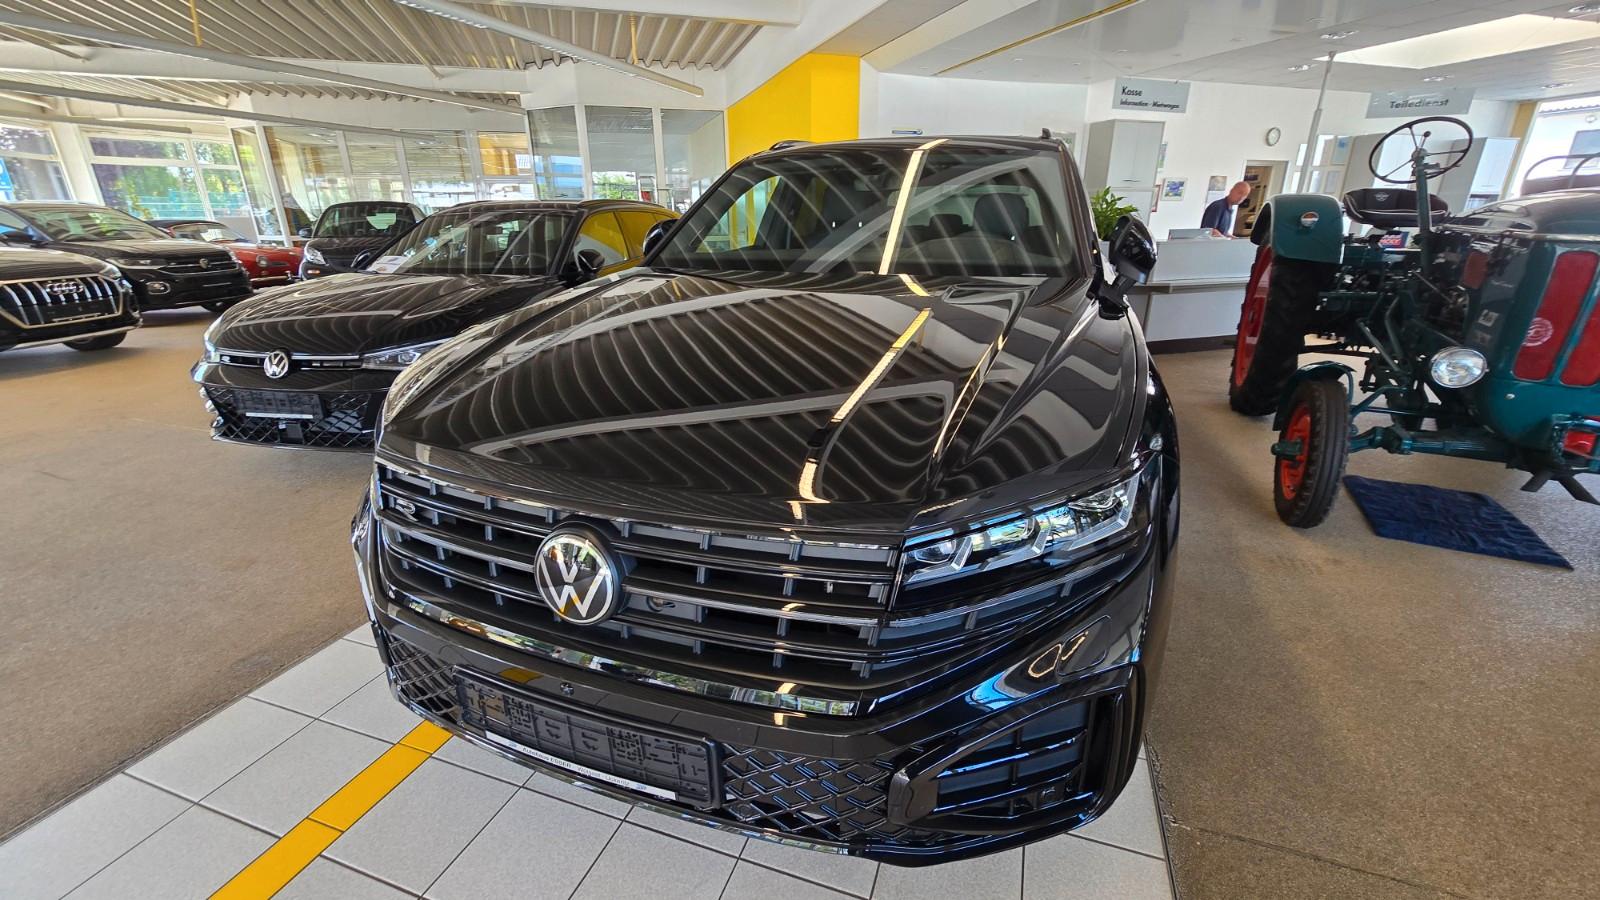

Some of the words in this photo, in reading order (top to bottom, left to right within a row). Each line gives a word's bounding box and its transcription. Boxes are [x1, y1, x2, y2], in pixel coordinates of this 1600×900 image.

[1121, 86, 1142, 96] Kasse
[1389, 99, 1449, 109] Teiledienst
[535, 535, 614, 625] VW
